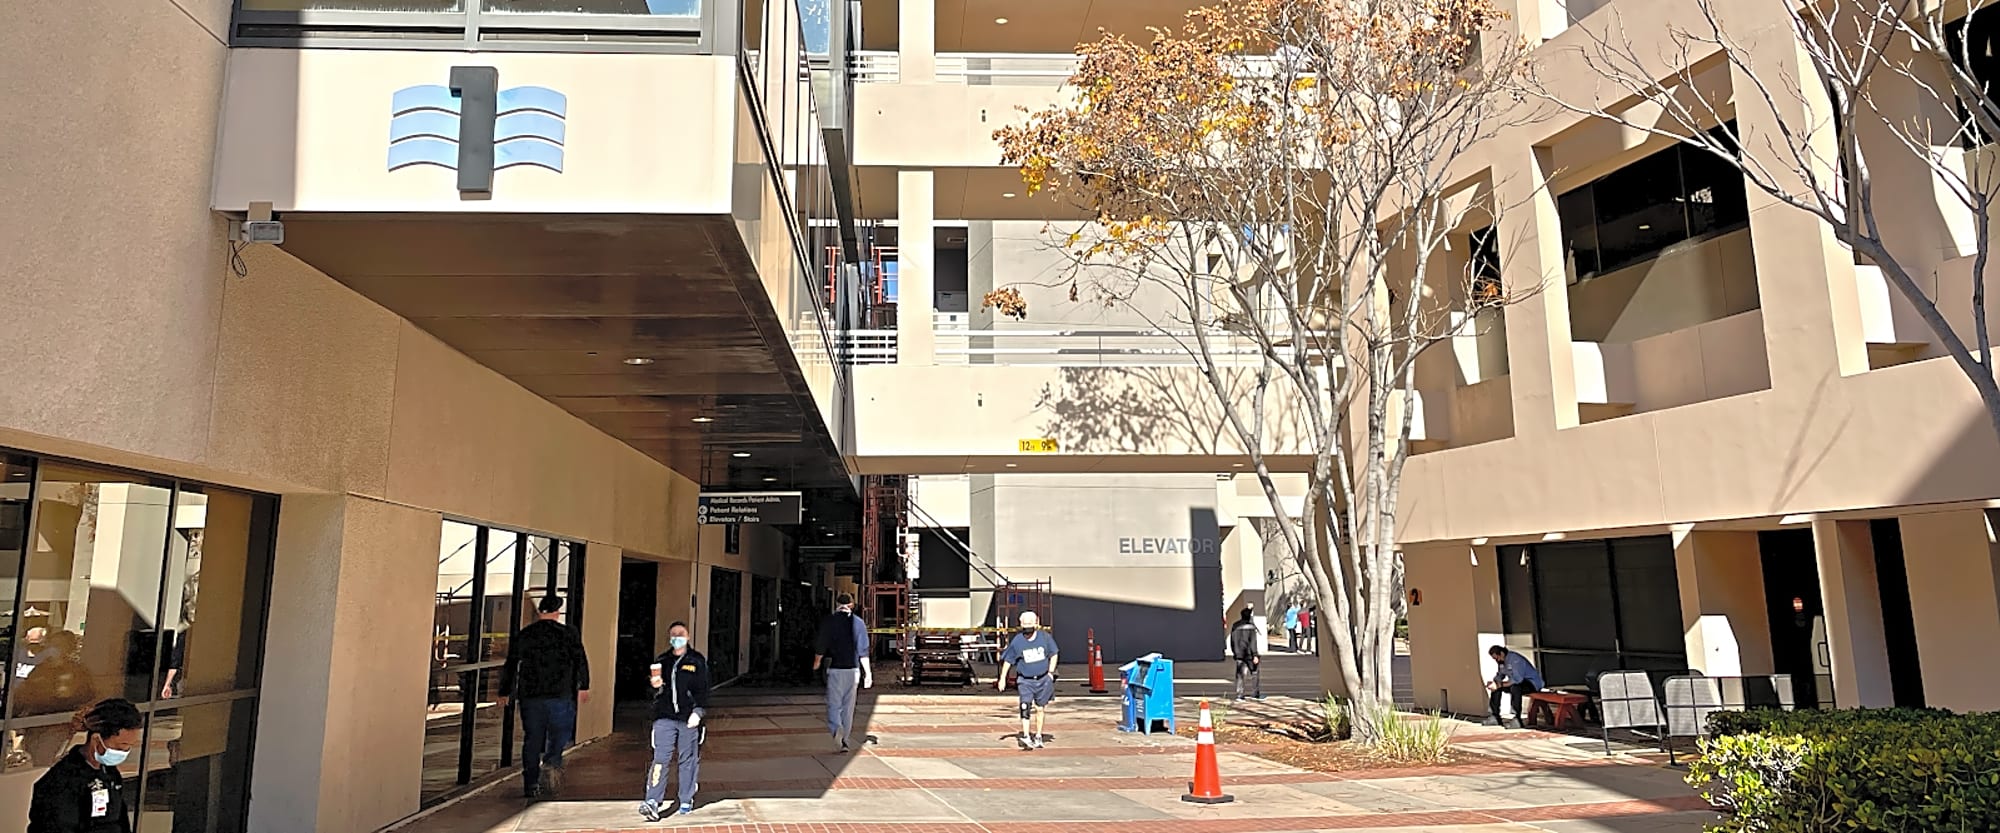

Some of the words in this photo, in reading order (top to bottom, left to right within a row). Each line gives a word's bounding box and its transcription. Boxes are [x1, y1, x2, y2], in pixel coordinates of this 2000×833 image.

[449, 66, 499, 192] 1
[1119, 537, 1215, 554] ELEVATOR
[1411, 588, 1420, 606] 2
